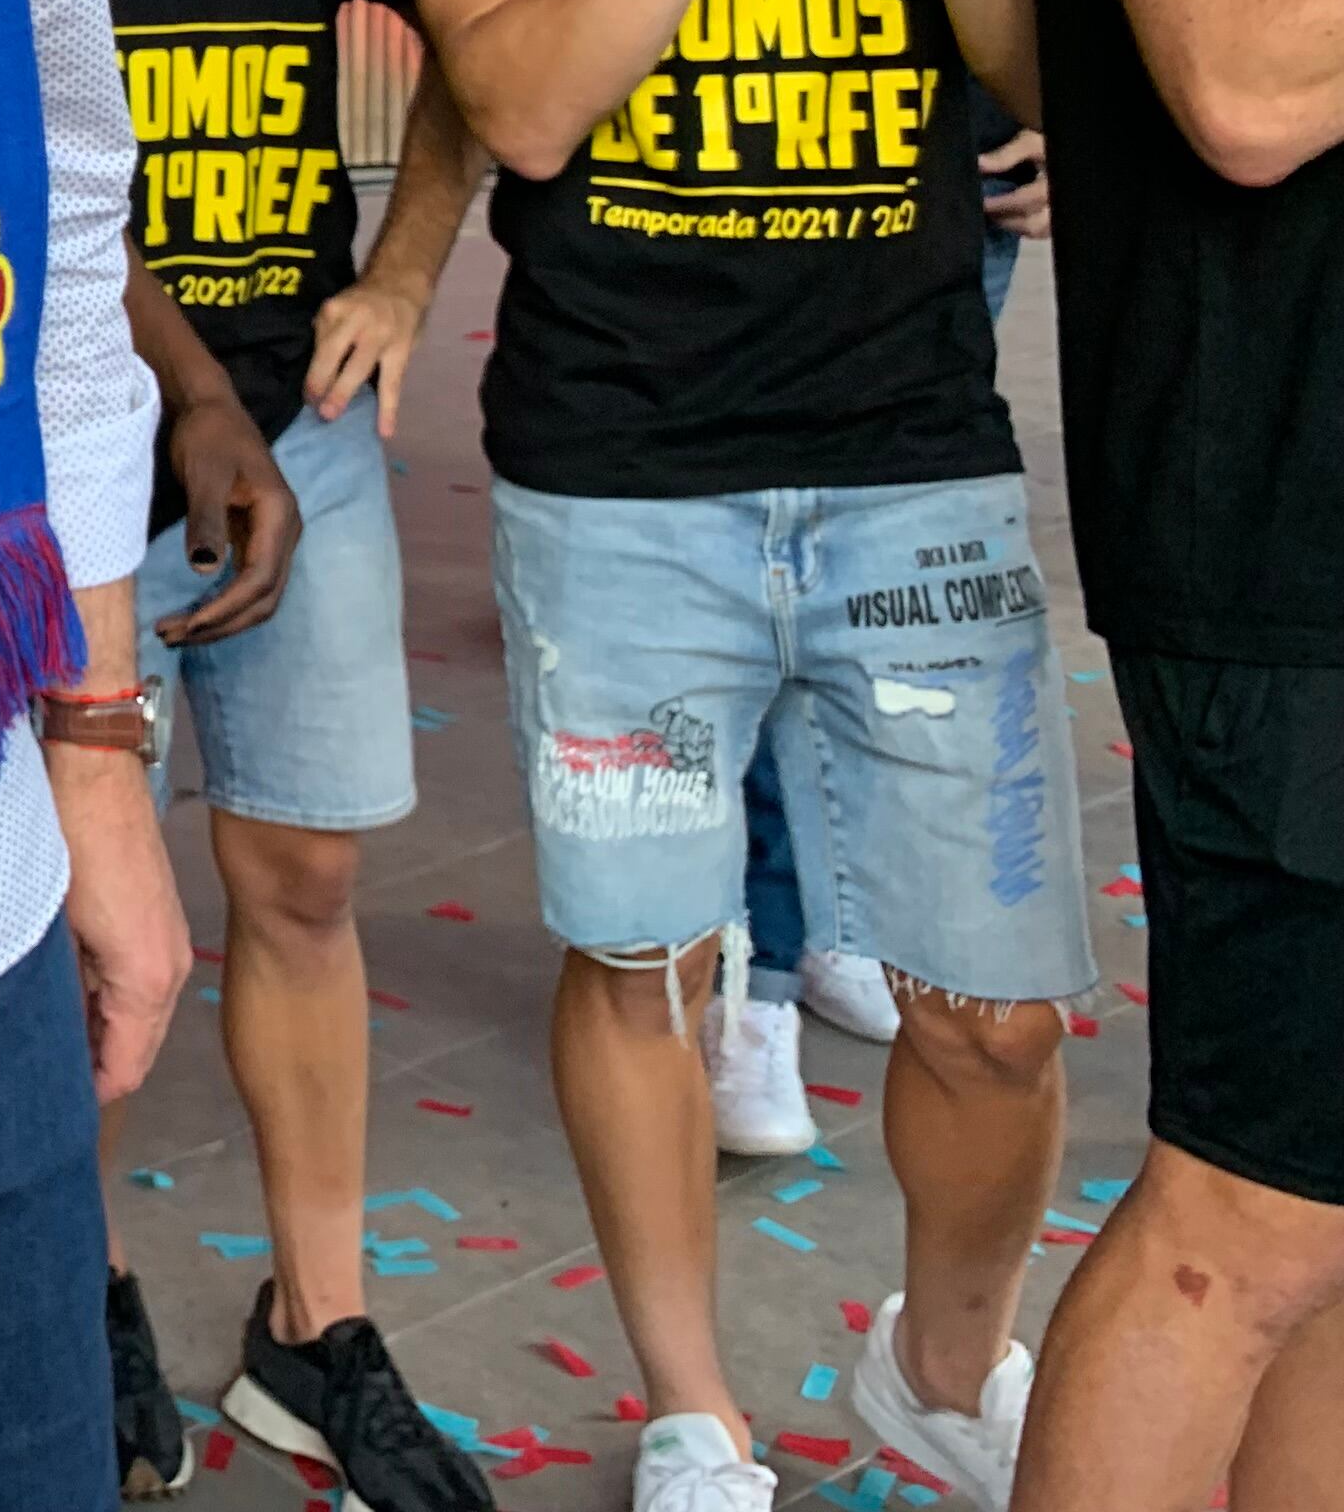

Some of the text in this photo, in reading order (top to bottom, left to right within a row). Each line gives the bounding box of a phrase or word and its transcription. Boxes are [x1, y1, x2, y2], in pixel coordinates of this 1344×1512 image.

[115, 44, 310, 143] OMOS
[587, 196, 758, 238] Temporada
[846, 581, 940, 628] VISUAL
